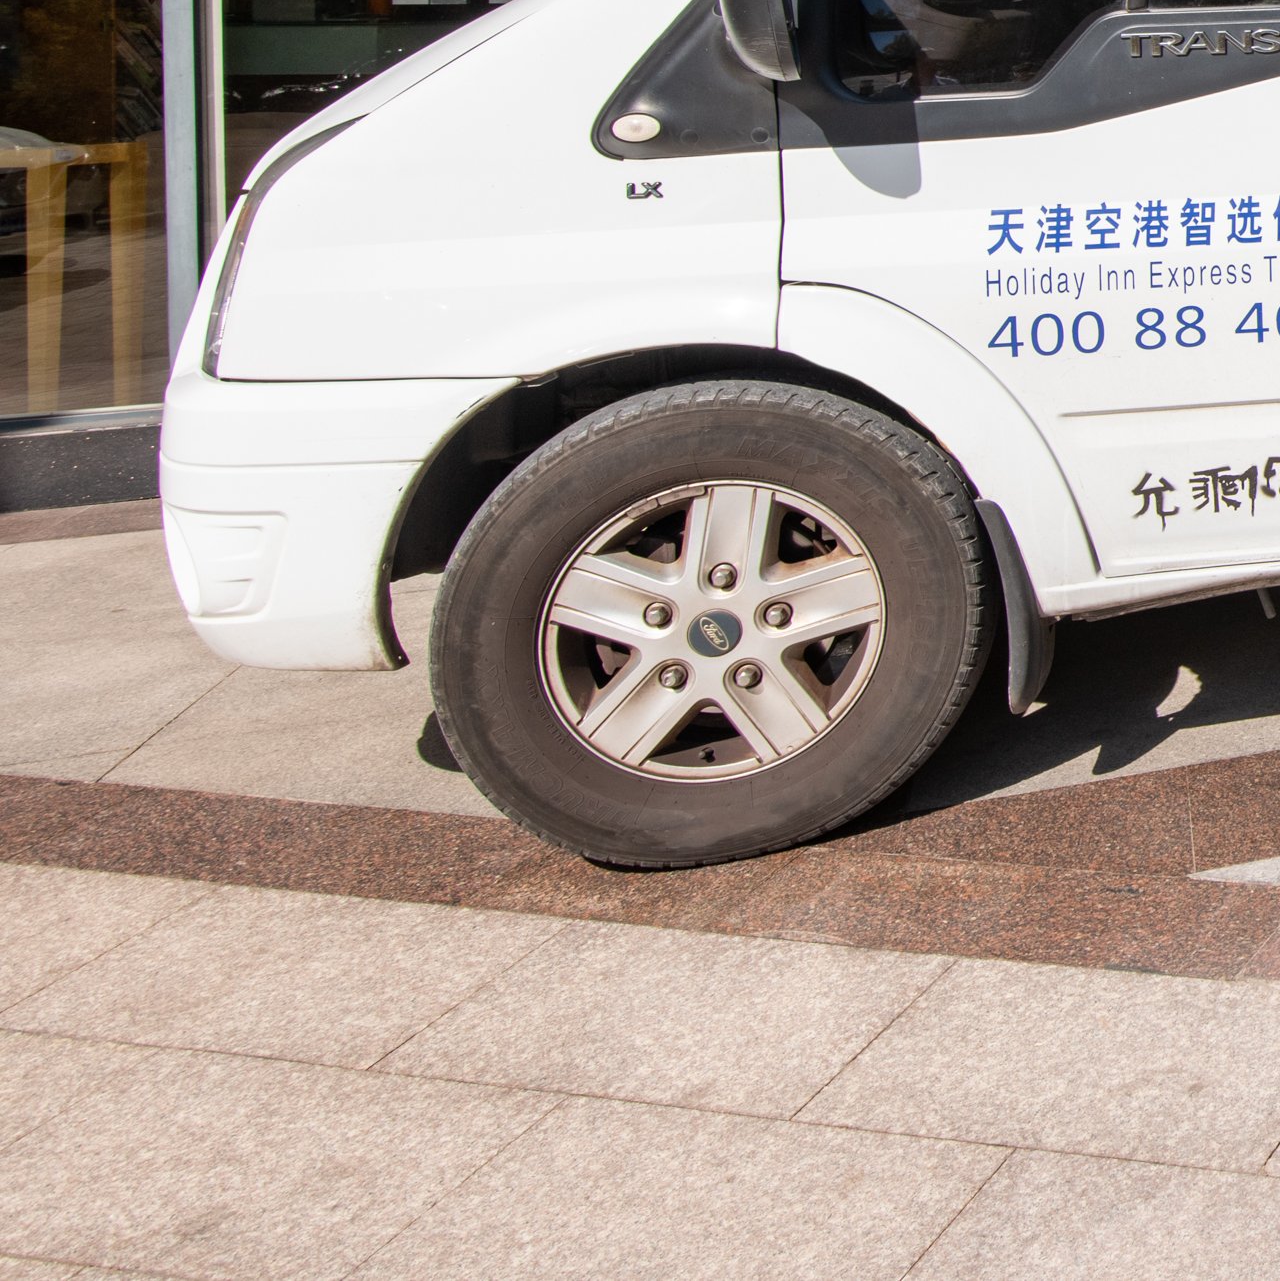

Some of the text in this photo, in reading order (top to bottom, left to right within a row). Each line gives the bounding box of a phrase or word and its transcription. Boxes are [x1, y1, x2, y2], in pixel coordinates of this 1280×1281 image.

[626, 182, 663, 199] LX
[985, 266, 1085, 300] Holiday
[1098, 264, 1136, 292] Inn
[1149, 260, 1252, 295] Express
[987, 310, 1105, 358] 400
[1135, 305, 1207, 351] 88
